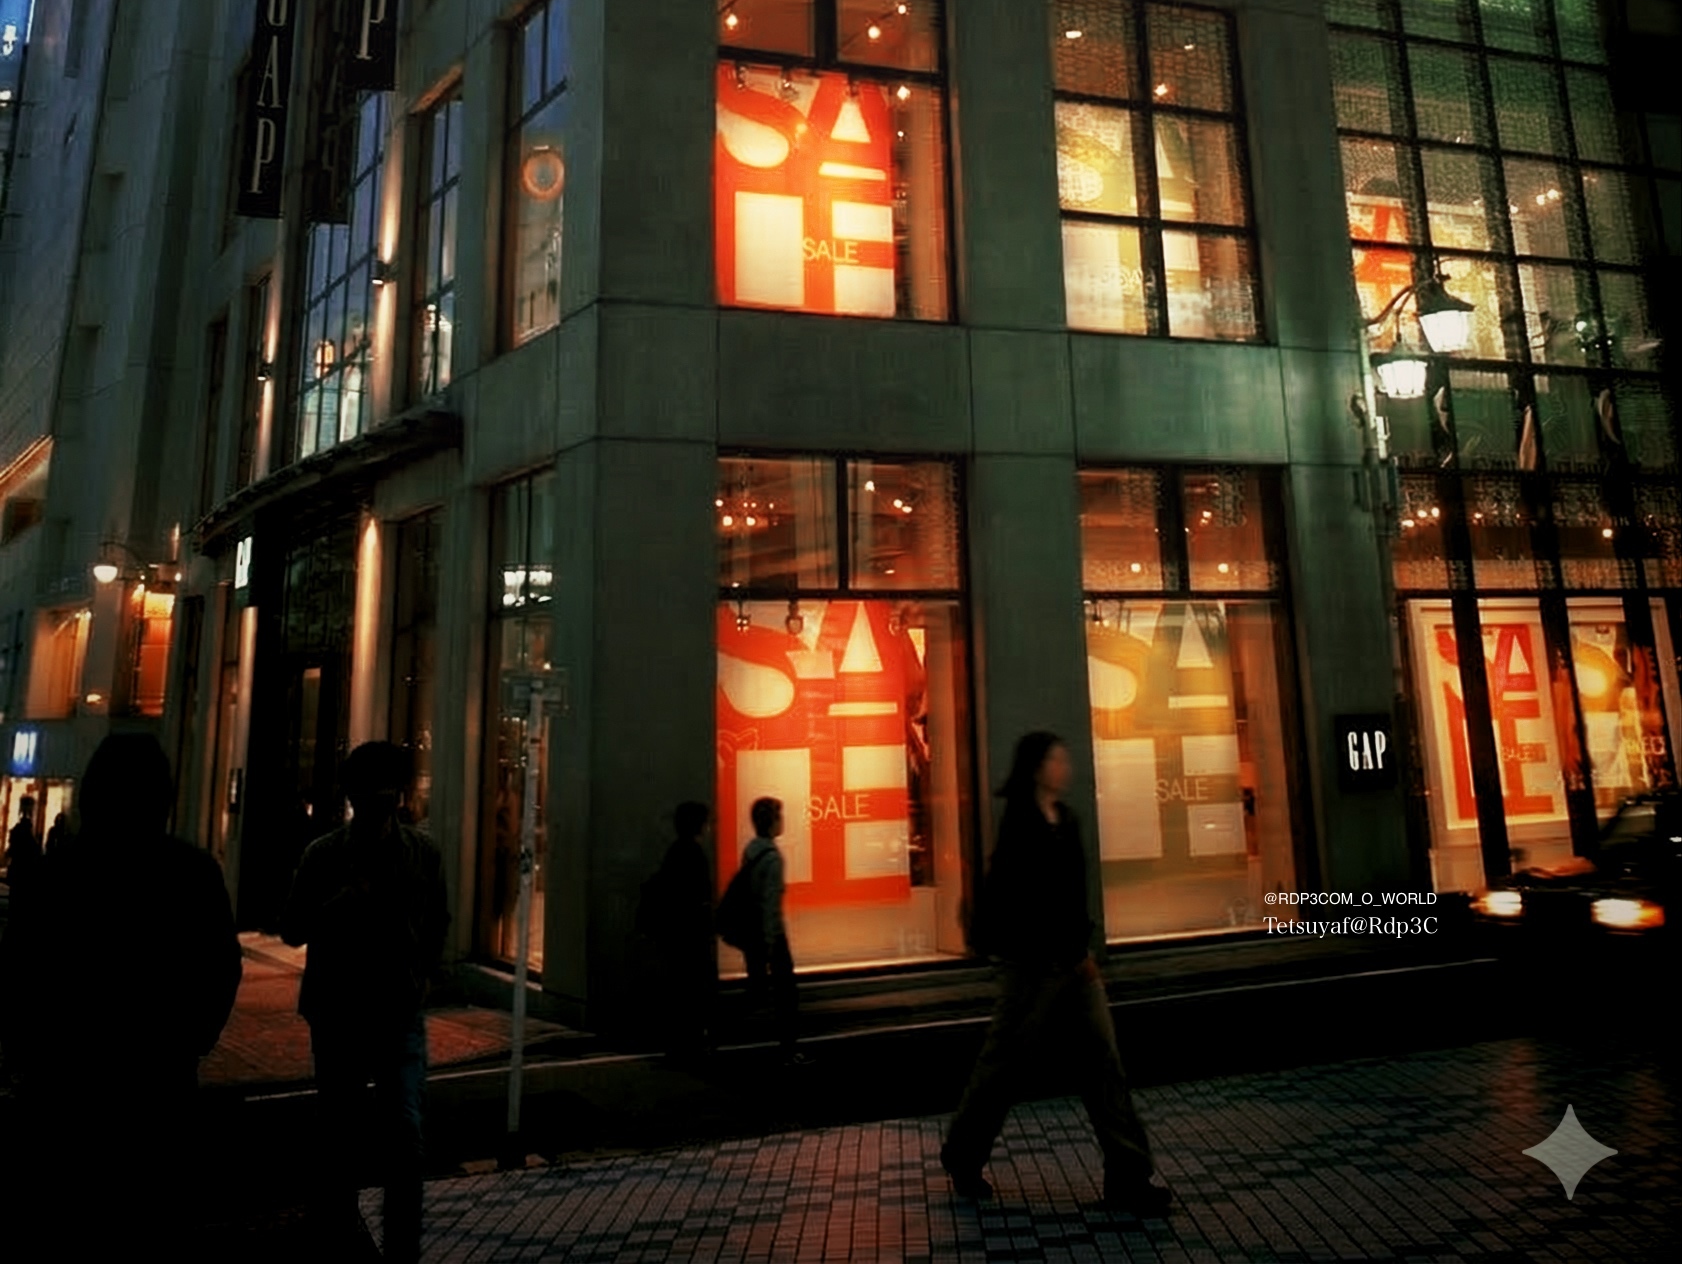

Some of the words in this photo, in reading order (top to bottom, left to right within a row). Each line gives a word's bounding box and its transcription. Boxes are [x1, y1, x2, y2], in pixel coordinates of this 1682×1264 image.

[801, 236, 860, 264] SALE
[1347, 730, 1387, 772] GAP
[1154, 777, 1210, 804] SALE
[806, 794, 871, 822] SALE
